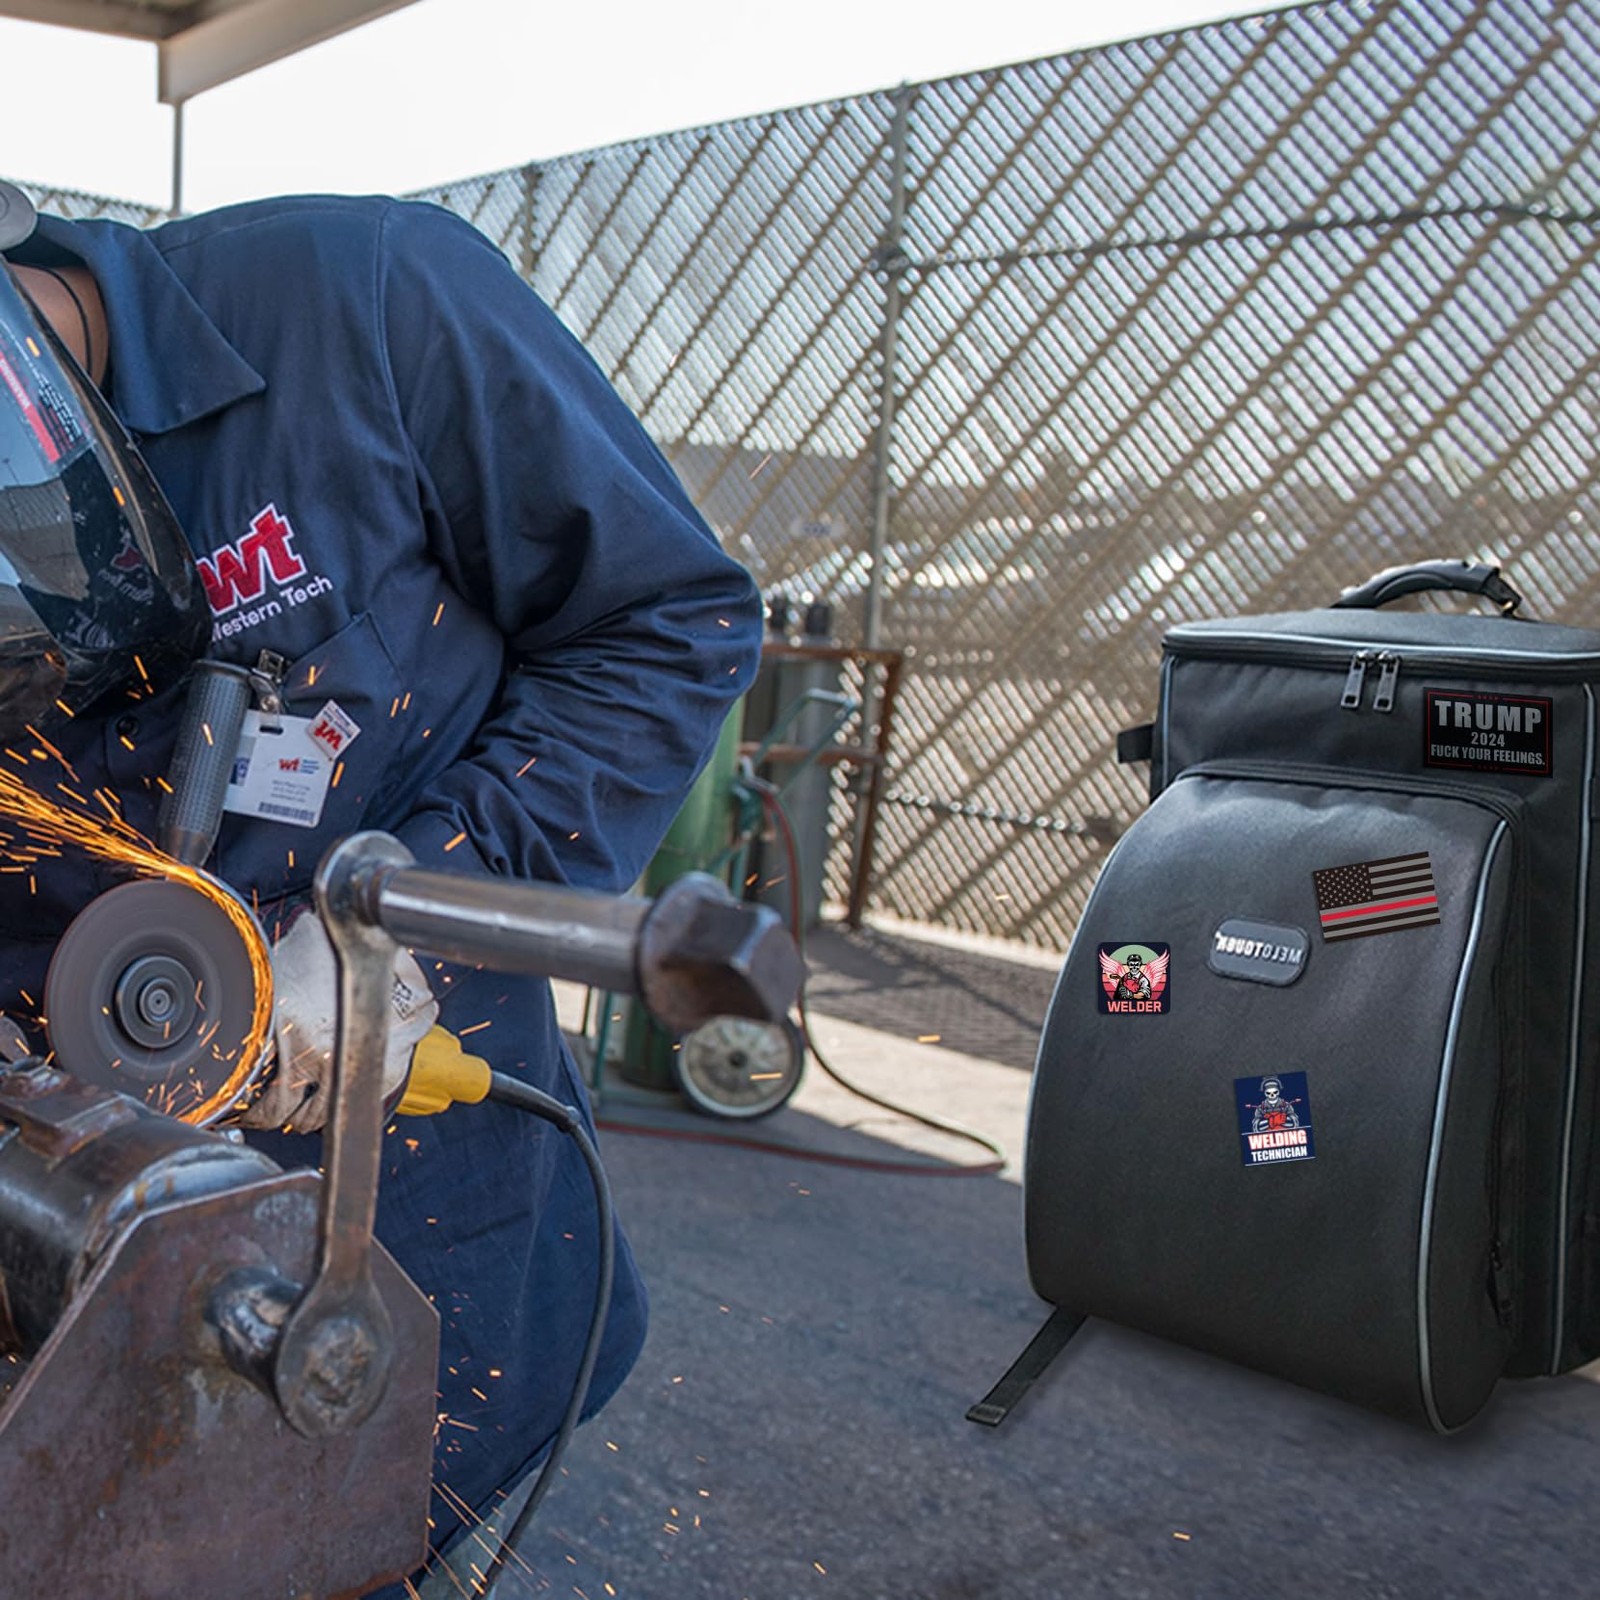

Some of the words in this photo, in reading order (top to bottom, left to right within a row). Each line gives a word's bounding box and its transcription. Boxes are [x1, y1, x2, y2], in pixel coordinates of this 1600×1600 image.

[279, 575, 333, 607] Tech
[1434, 700, 1541, 733] TRUMP
[1471, 732, 1505, 748] 2024
[1431, 744, 1459, 758] FUCK
[1462, 747, 1491, 761] YOUR
[1493, 749, 1546, 766] FEELINGS.
[1107, 1001, 1162, 1013] WELDER
[1247, 1129, 1308, 1150] WELDING
[1251, 1146, 1308, 1163] TECHNICIAN
